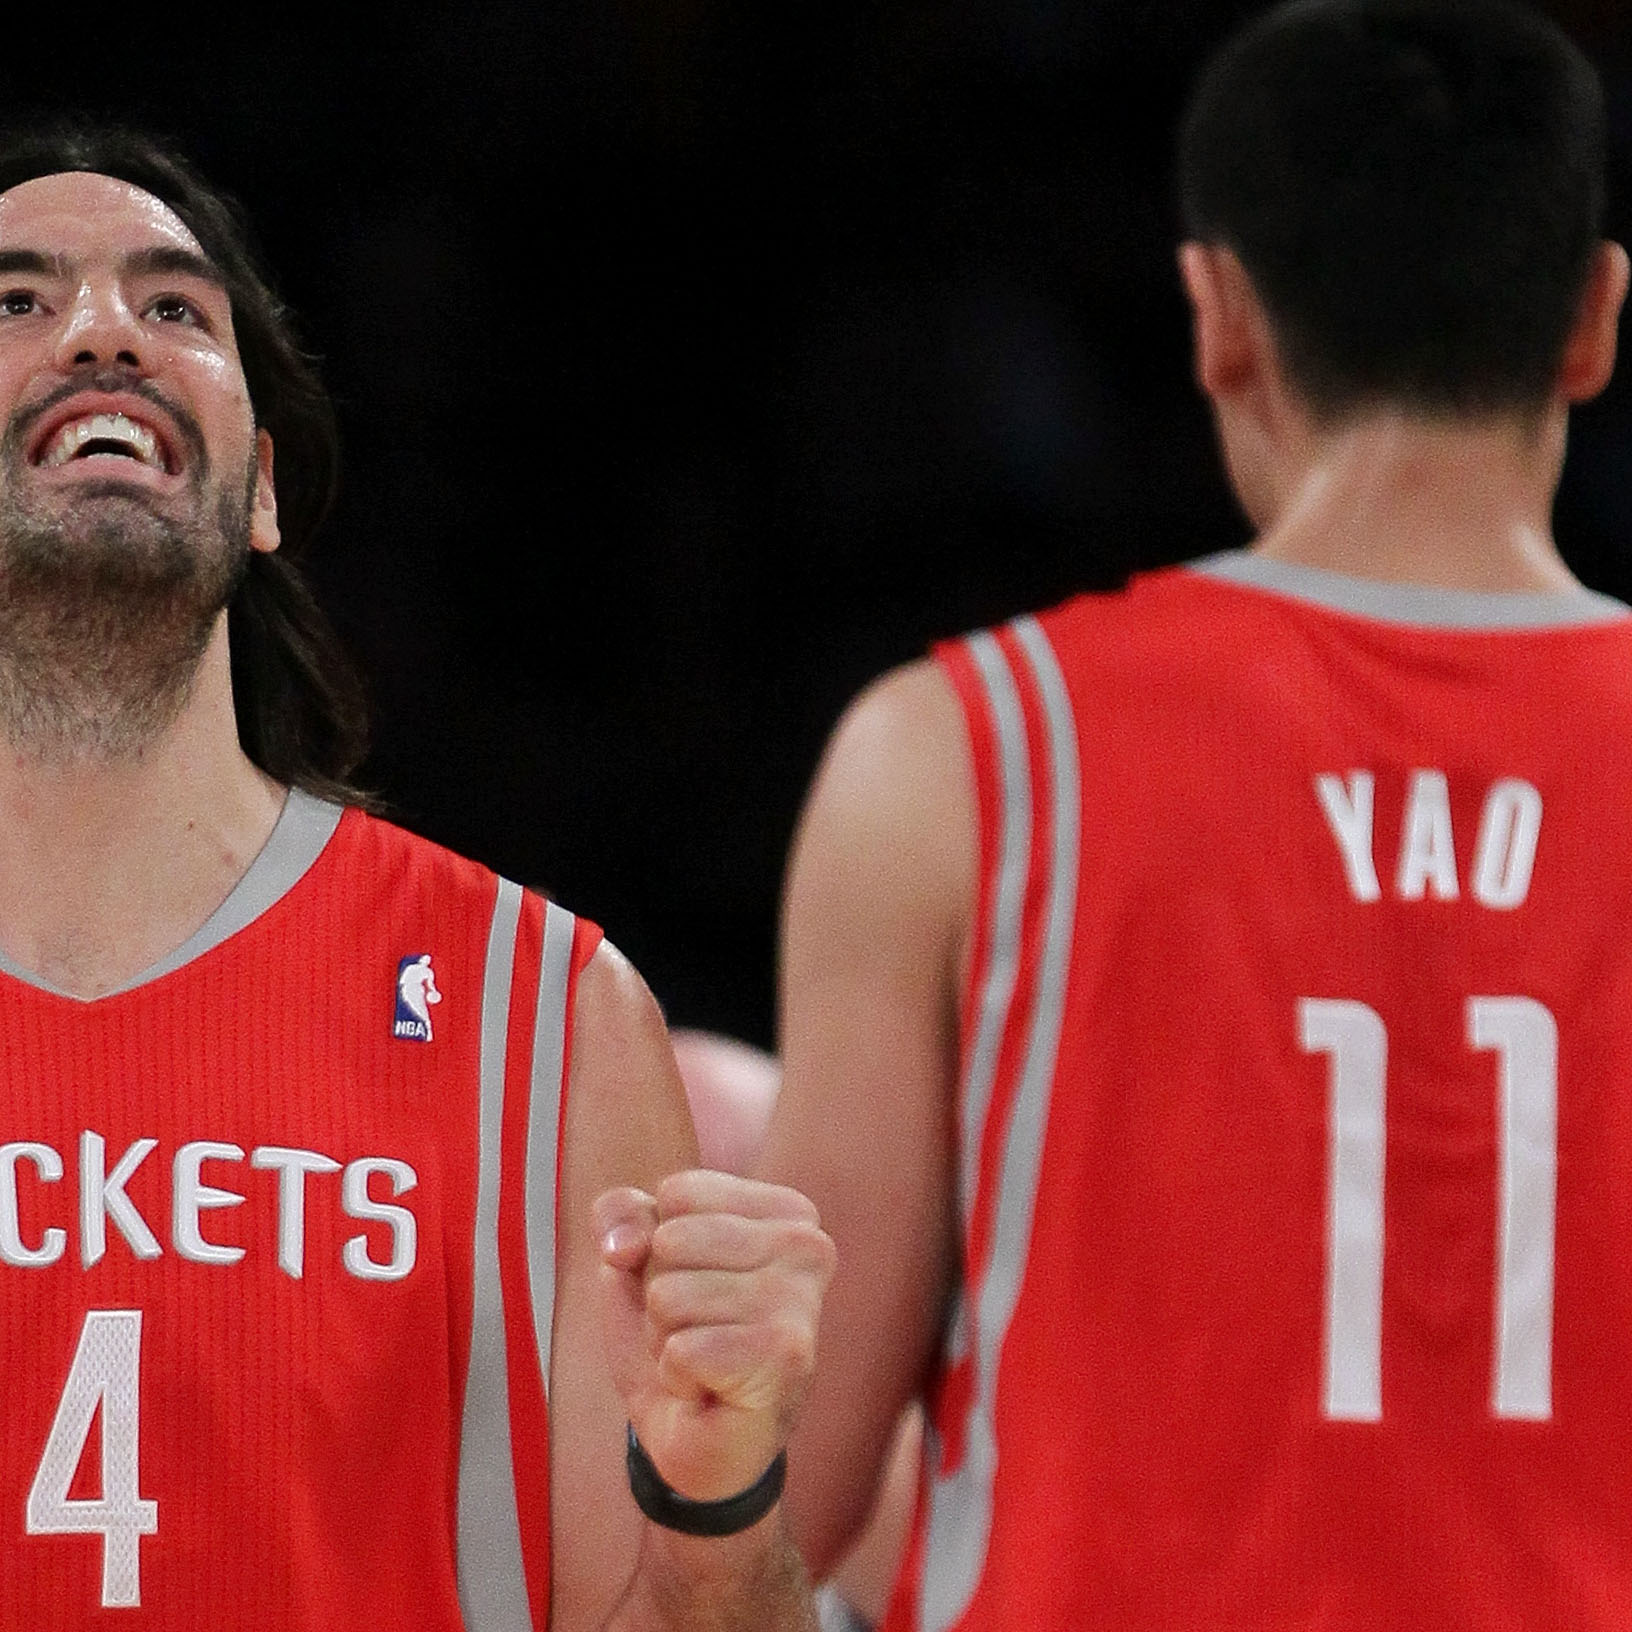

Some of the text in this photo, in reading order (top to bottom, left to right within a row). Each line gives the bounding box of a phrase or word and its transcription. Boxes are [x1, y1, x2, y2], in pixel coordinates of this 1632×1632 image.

[1315, 768, 1543, 911] YAO
[395, 1020, 425, 1037] NBA
[1295, 995, 1559, 1423] 11
[25, 1309, 158, 1608] 4
